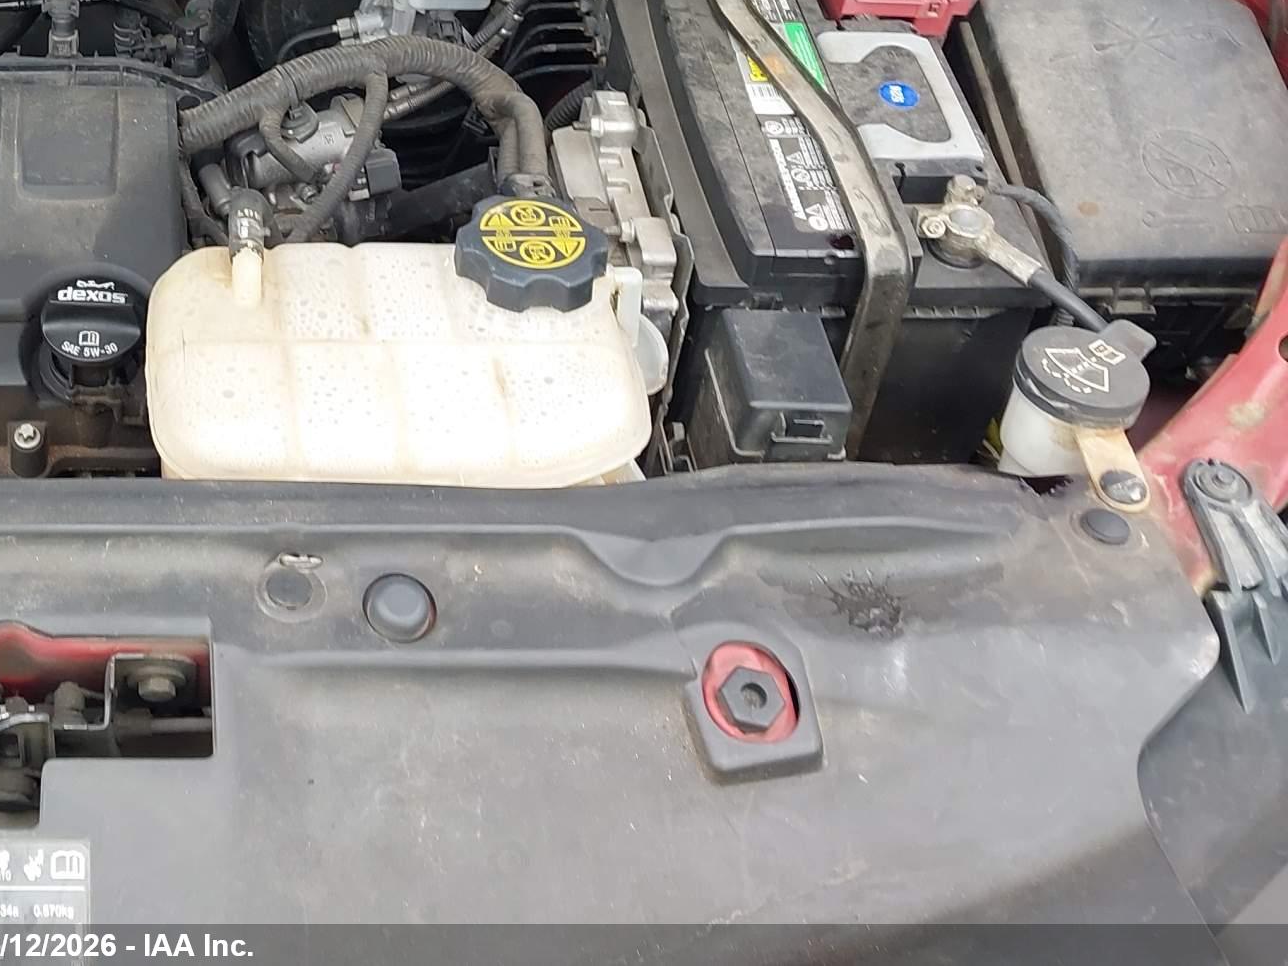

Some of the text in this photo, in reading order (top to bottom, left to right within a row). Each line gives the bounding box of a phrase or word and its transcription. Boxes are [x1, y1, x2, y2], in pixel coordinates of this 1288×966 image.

[57, 286, 126, 304] dexos
[61, 340, 118, 358] SAE 5W-30
